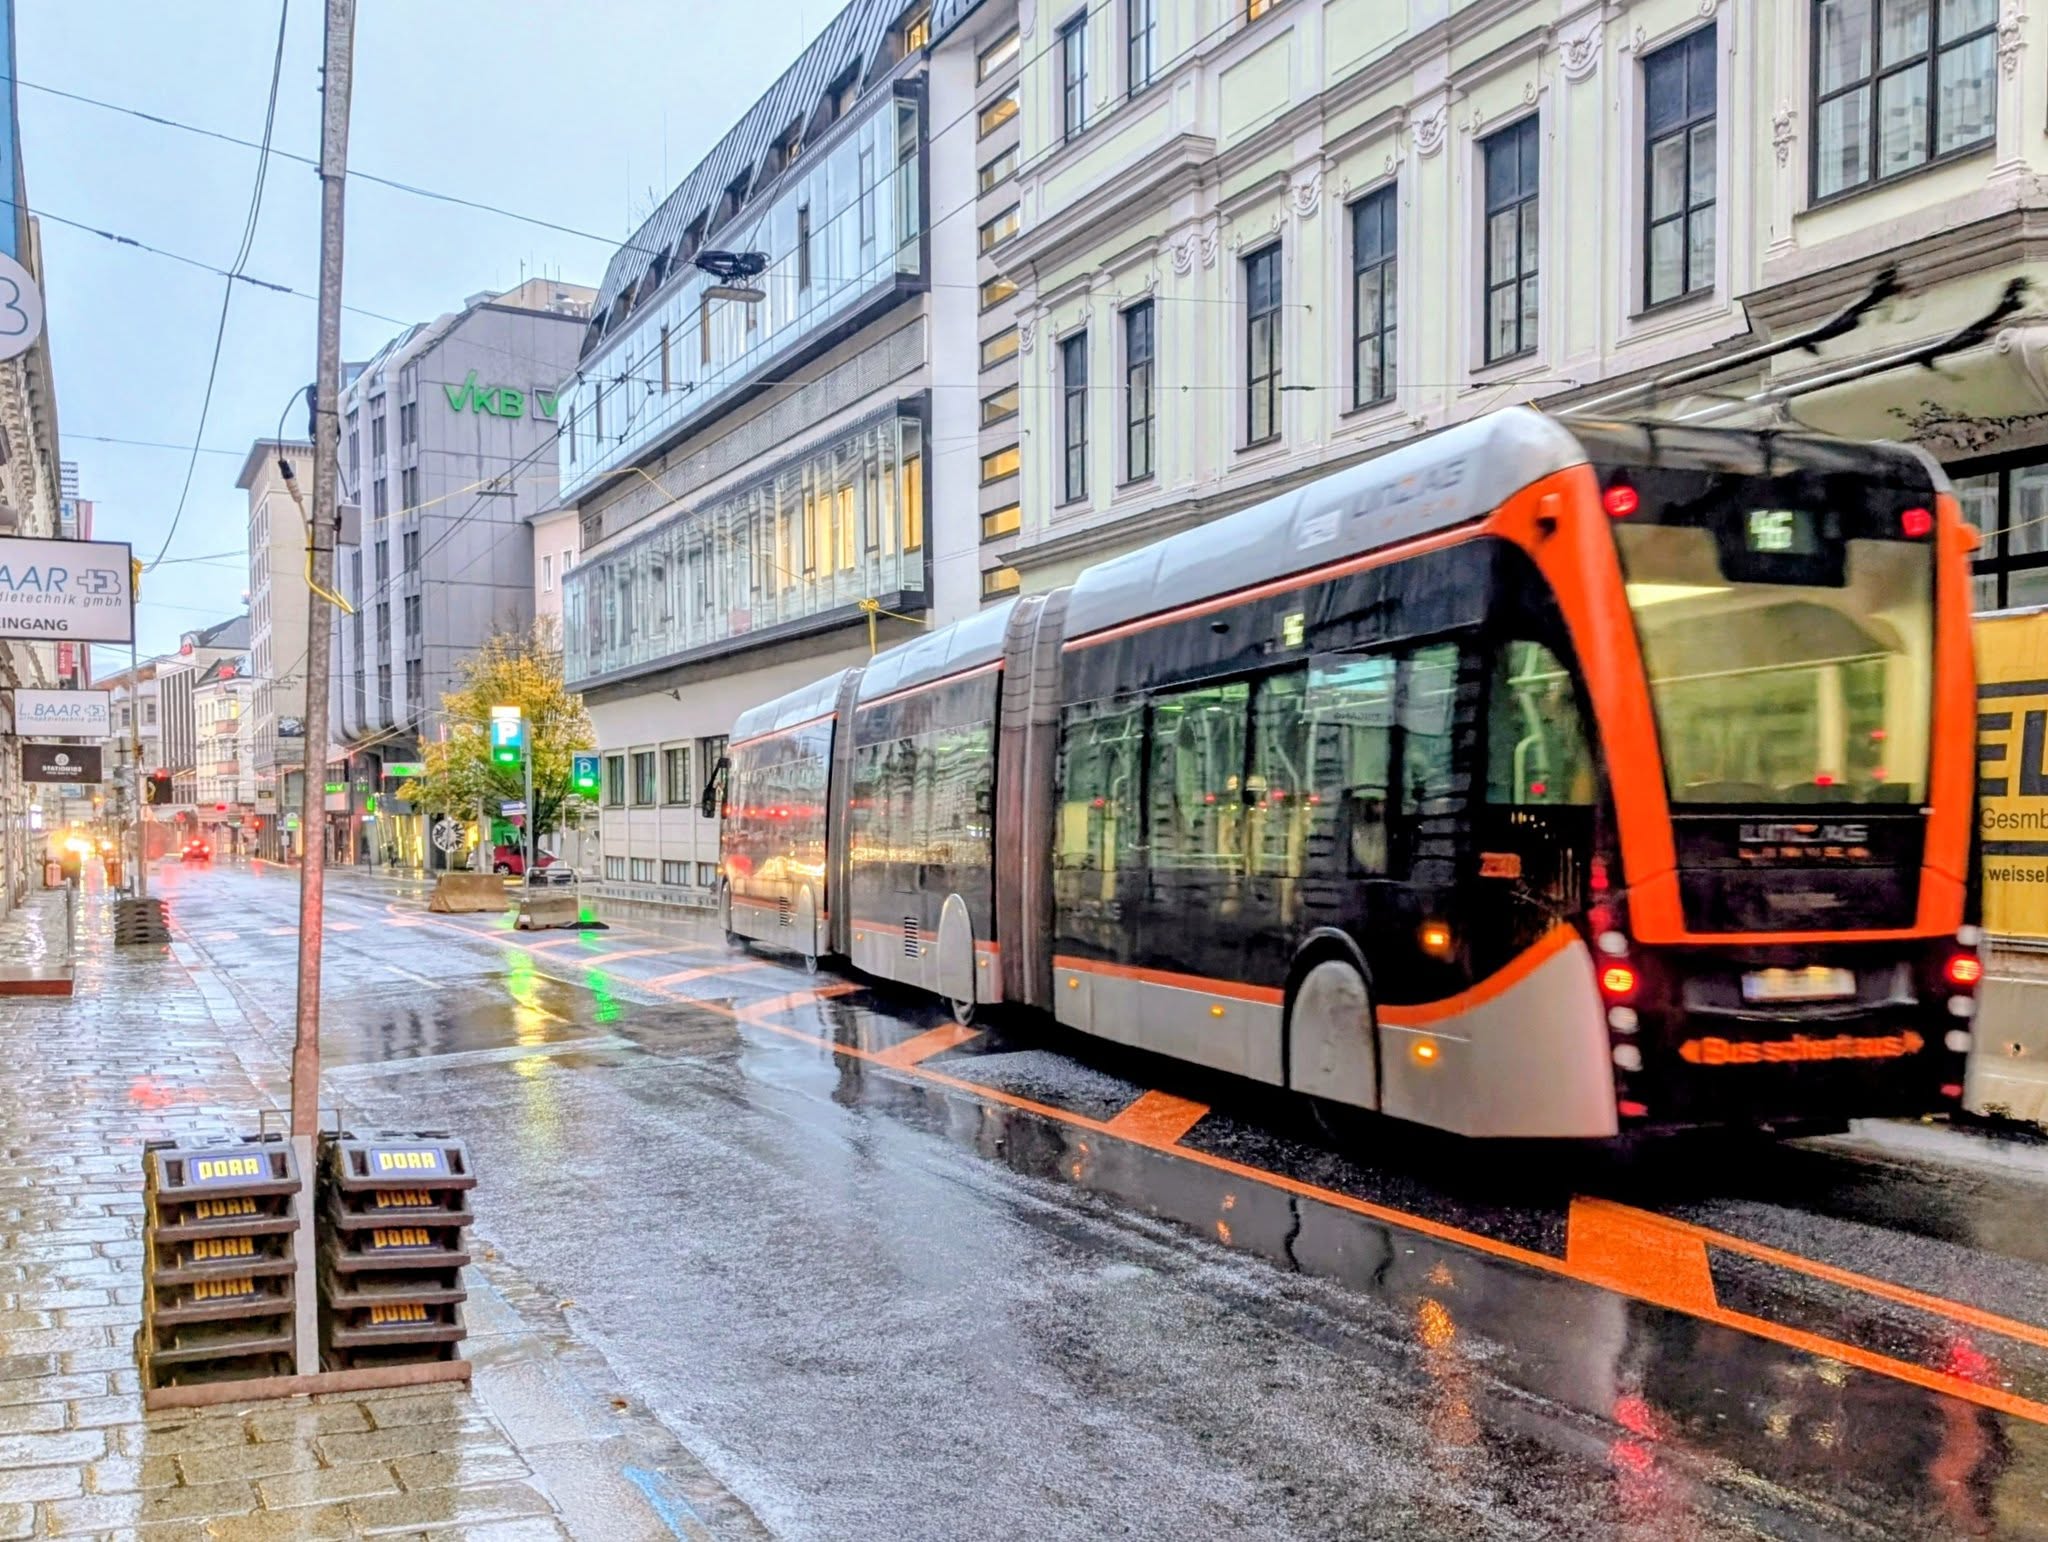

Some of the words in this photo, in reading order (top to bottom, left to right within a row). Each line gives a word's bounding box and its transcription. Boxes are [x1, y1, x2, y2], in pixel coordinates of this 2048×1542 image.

[443, 369, 525, 418] VKB
[83, 596, 122, 608] gmbh
[0, 617, 68, 631] INGANG
[34, 703, 81, 717] BAAR
